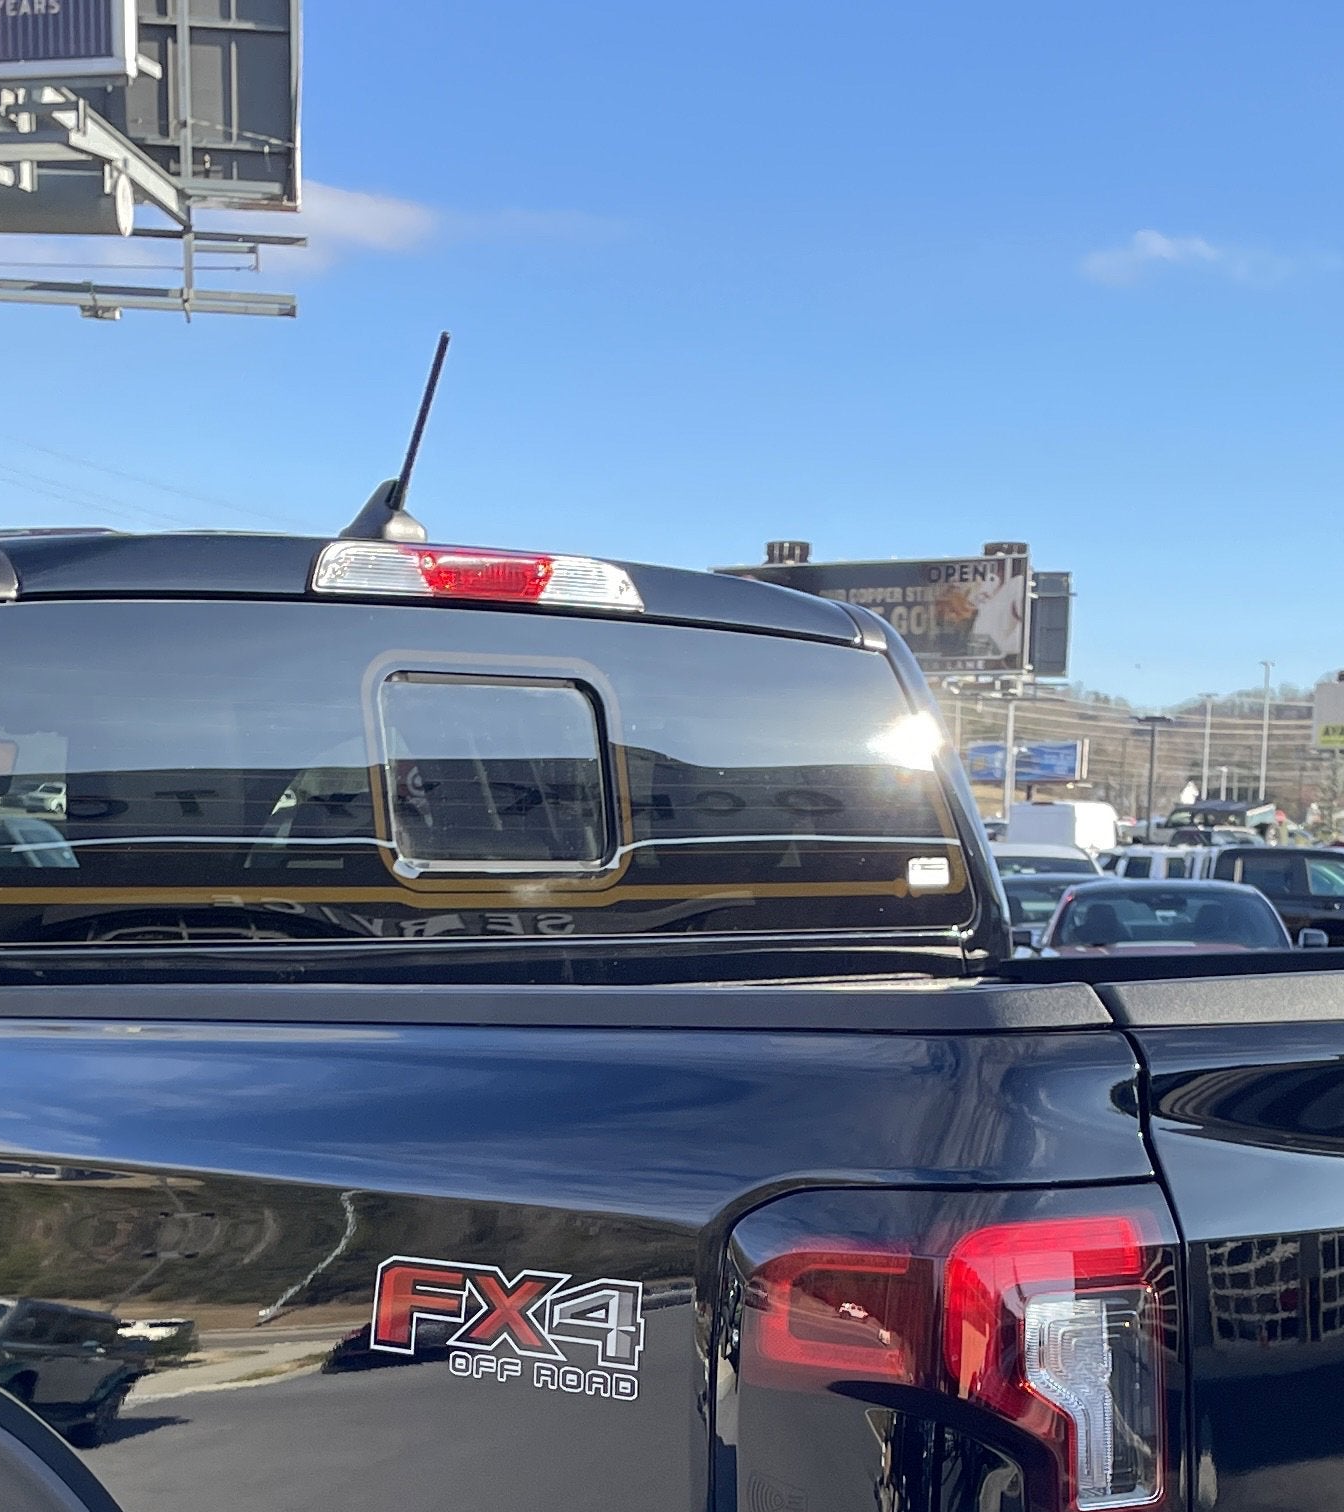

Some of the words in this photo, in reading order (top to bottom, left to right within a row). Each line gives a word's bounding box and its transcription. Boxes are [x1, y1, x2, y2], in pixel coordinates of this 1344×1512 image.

[927, 560, 998, 585] OPEN!
[848, 586, 903, 604] COPPER
[369, 1254, 646, 1371] FX4
[449, 1350, 522, 1382] OFF
[533, 1361, 639, 1401] ROAD
